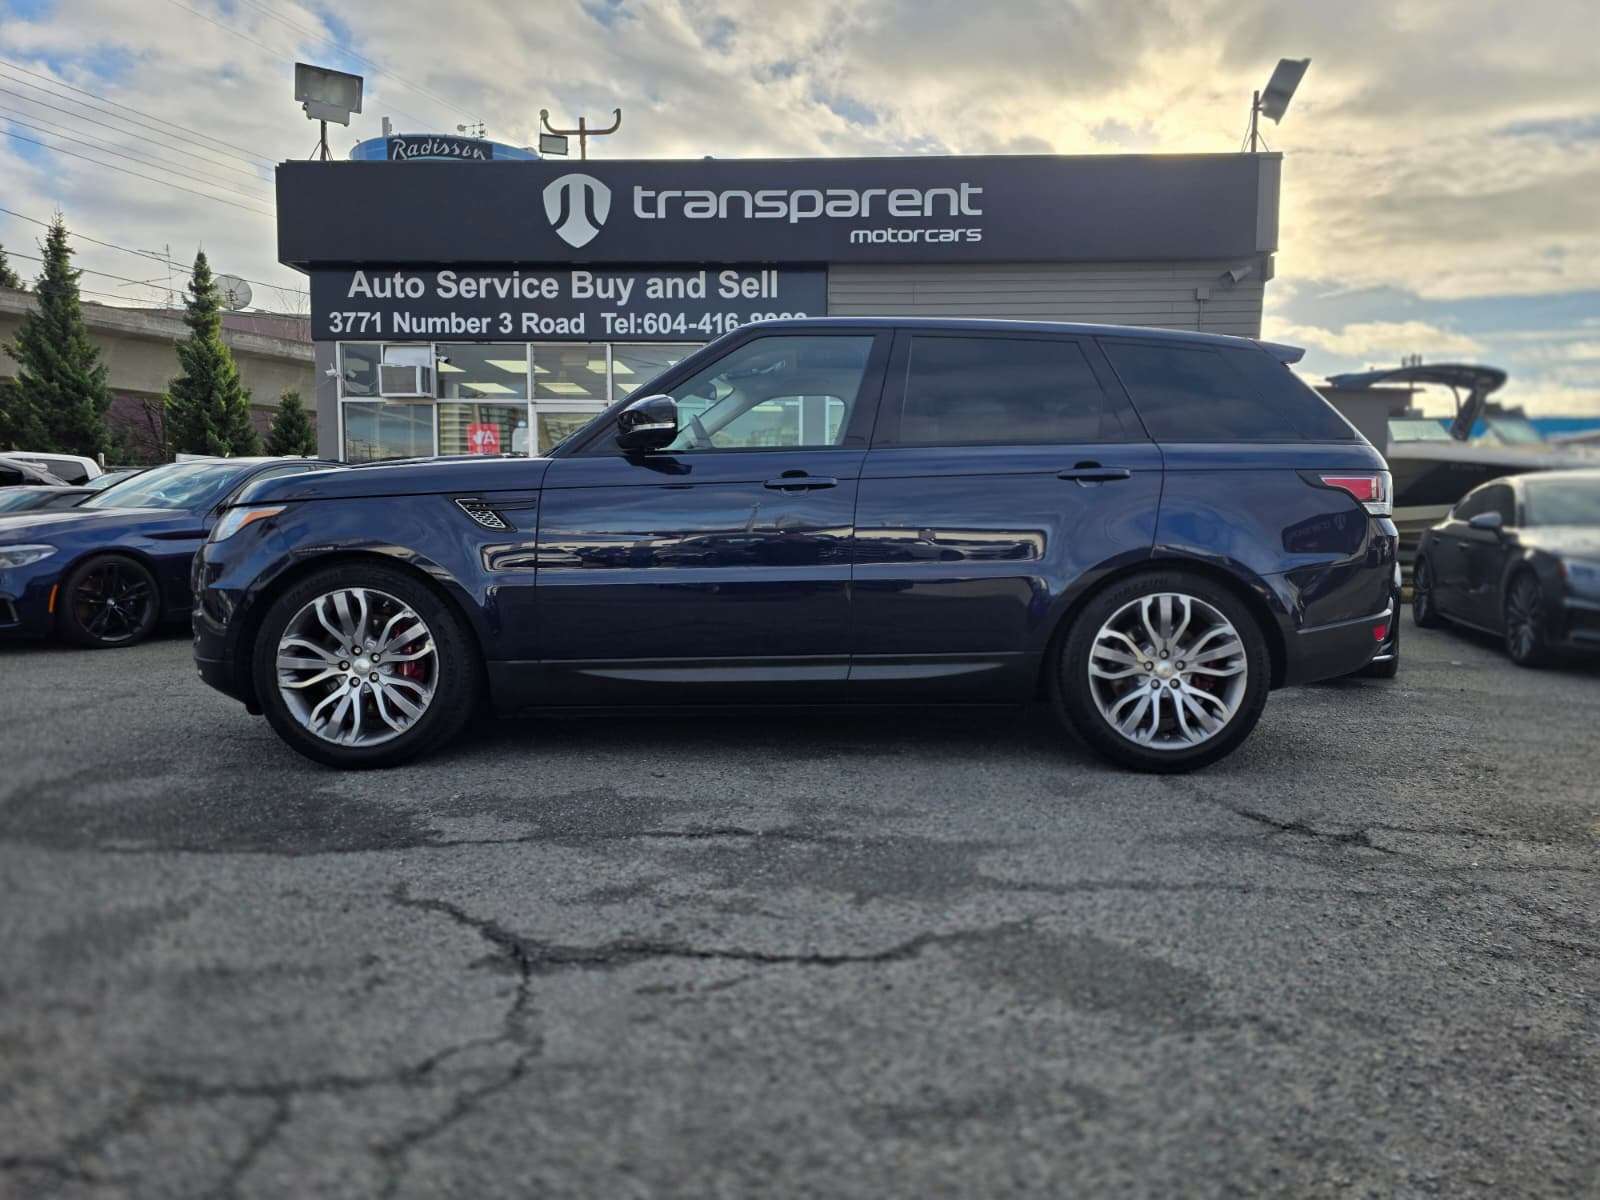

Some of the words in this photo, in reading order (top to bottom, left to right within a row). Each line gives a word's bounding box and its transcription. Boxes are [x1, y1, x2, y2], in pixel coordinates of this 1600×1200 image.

[392, 138, 486, 160] Radisson
[633, 182, 983, 223] transparent
[850, 227, 982, 243] motorcars
[347, 270, 425, 298] Auto
[436, 270, 559, 298] Service
[571, 270, 635, 306] Buy
[646, 270, 706, 299] and
[718, 270, 778, 299] Sell
[329, 311, 382, 333] 3771
[393, 311, 491, 333] Number
[499, 312, 513, 333] 3
[521, 311, 585, 333] Road
